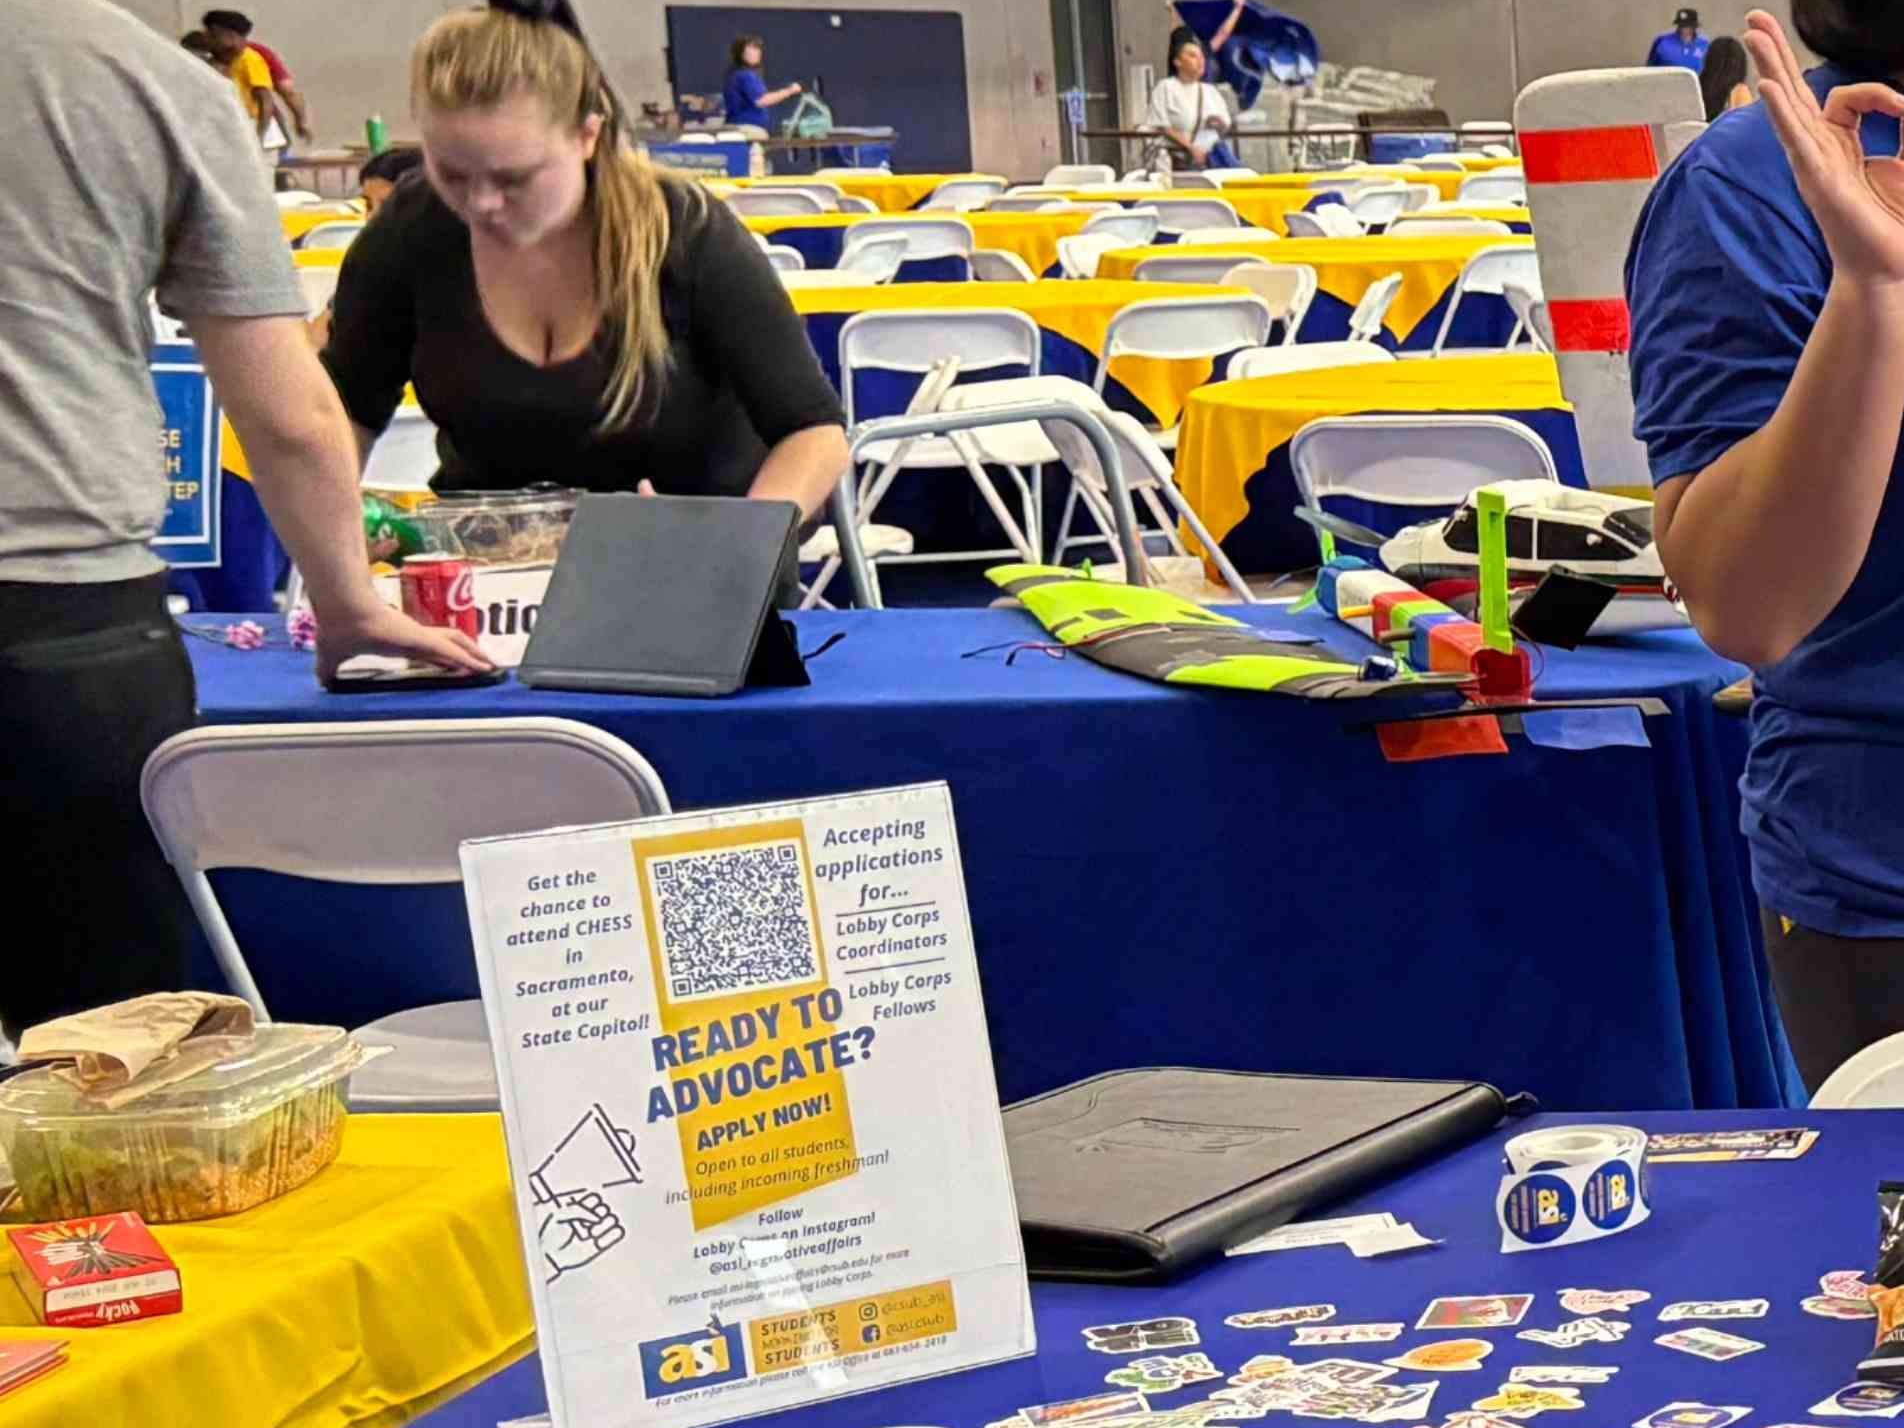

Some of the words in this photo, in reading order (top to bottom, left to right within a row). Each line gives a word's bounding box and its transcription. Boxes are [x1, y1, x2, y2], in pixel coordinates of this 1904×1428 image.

[823, 819, 926, 847] Accepting
[814, 846, 944, 882] applications
[528, 874, 559, 891] Get
[565, 870, 597, 886] the
[520, 896, 586, 919] chance
[592, 895, 611, 908] to
[858, 883, 909, 907] for...
[506, 923, 570, 946] attend
[576, 914, 633, 937] CHESS
[836, 915, 888, 936] Lobby
[892, 908, 940, 929] Corps
[566, 948, 583, 965] in
[836, 931, 948, 961] Coordinators
[516, 968, 634, 998] Sacramento,
[849, 978, 899, 999] Lobby
[904, 971, 952, 991] Corps
[551, 1003, 571, 1018] at
[577, 997, 609, 1013] our
[872, 998, 937, 1020] Fellows
[522, 1027, 572, 1048] State
[578, 1013, 650, 1040] Capitol!
[651, 1002, 781, 1072] READY
[791, 987, 843, 1029] TO
[646, 1025, 876, 1124] ADVOCATE?
[696, 1112, 766, 1152] APPLY
[772, 1092, 832, 1128] NOW!
[695, 1156, 736, 1176] Open
[741, 1152, 756, 1166] to
[760, 1146, 779, 1164] all
[740, 1165, 810, 1190] incoming
[757, 1206, 804, 1226] Follow
[693, 1239, 735, 1260] Lobby
[780, 1228, 798, 1240] on
[802, 1211, 876, 1237] Instagram!
[95, 1299, 141, 1322] Pocky
[761, 1309, 836, 1336] STUDENTS
[659, 1334, 730, 1384] asi
